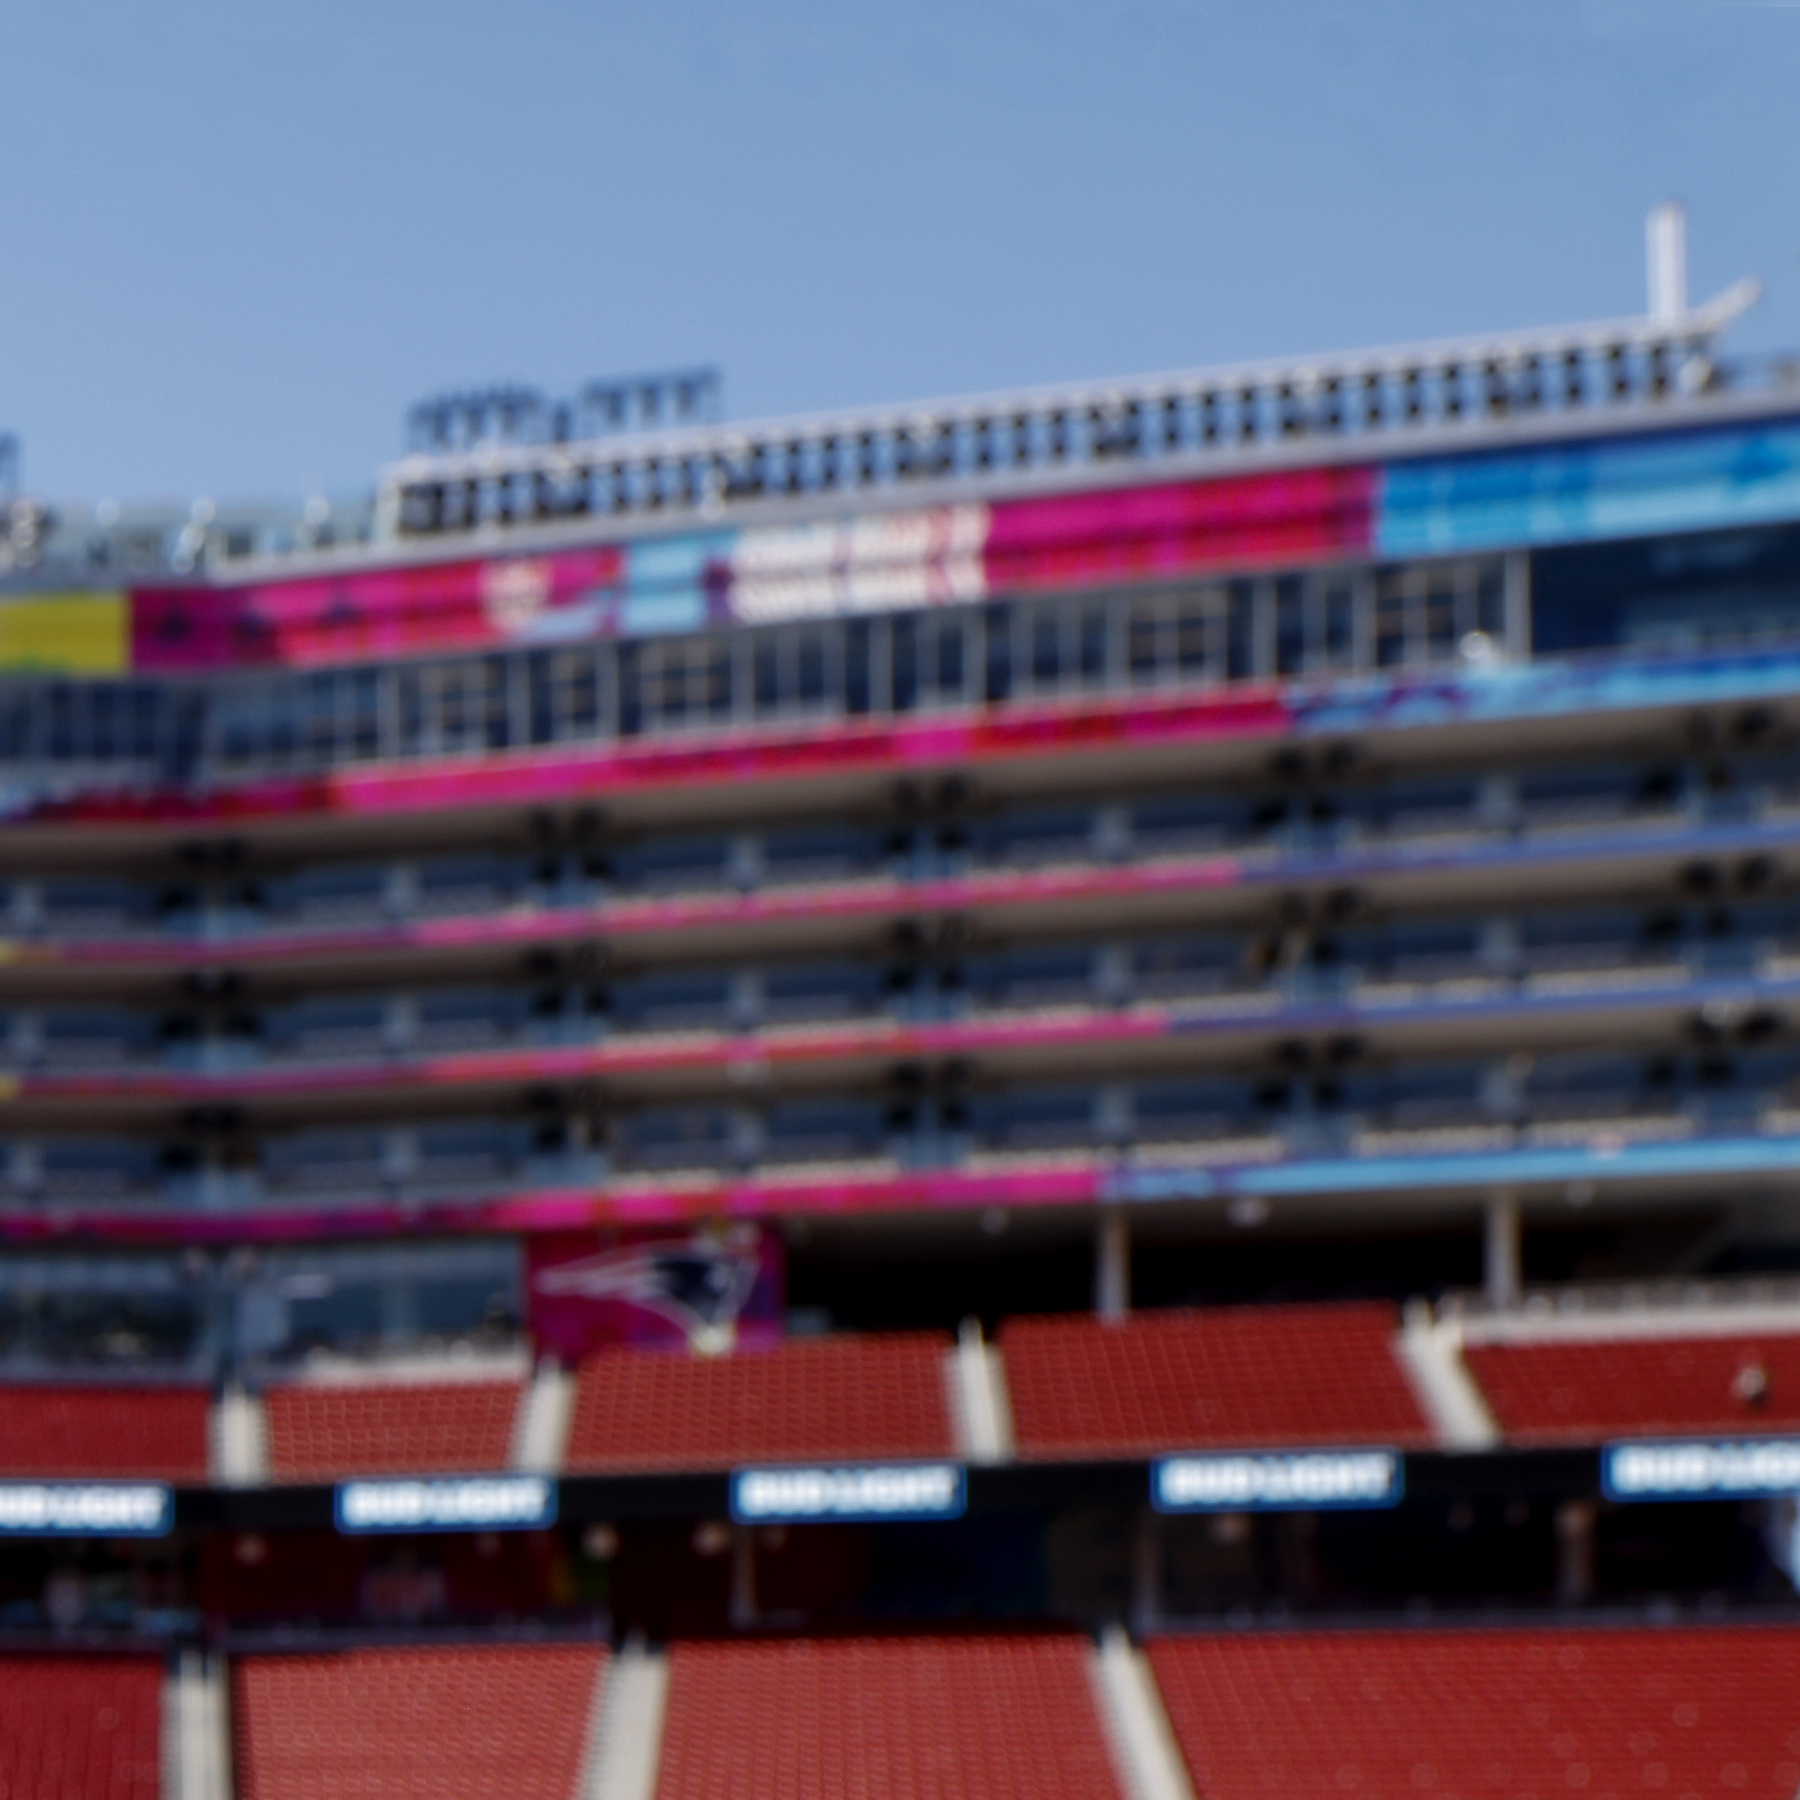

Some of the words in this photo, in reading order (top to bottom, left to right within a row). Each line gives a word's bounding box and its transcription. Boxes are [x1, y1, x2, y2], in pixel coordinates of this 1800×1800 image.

[743, 1470, 827, 1514] BUD
[828, 1466, 954, 1511] LIGHT
[1163, 1458, 1257, 1503] BUD
[1258, 1454, 1390, 1499] LIGHT
[1613, 1446, 1707, 1493] BUD
[53, 1487, 161, 1526] LIGHT
[346, 1484, 430, 1525] BUD
[431, 1479, 546, 1522] LIGHT
